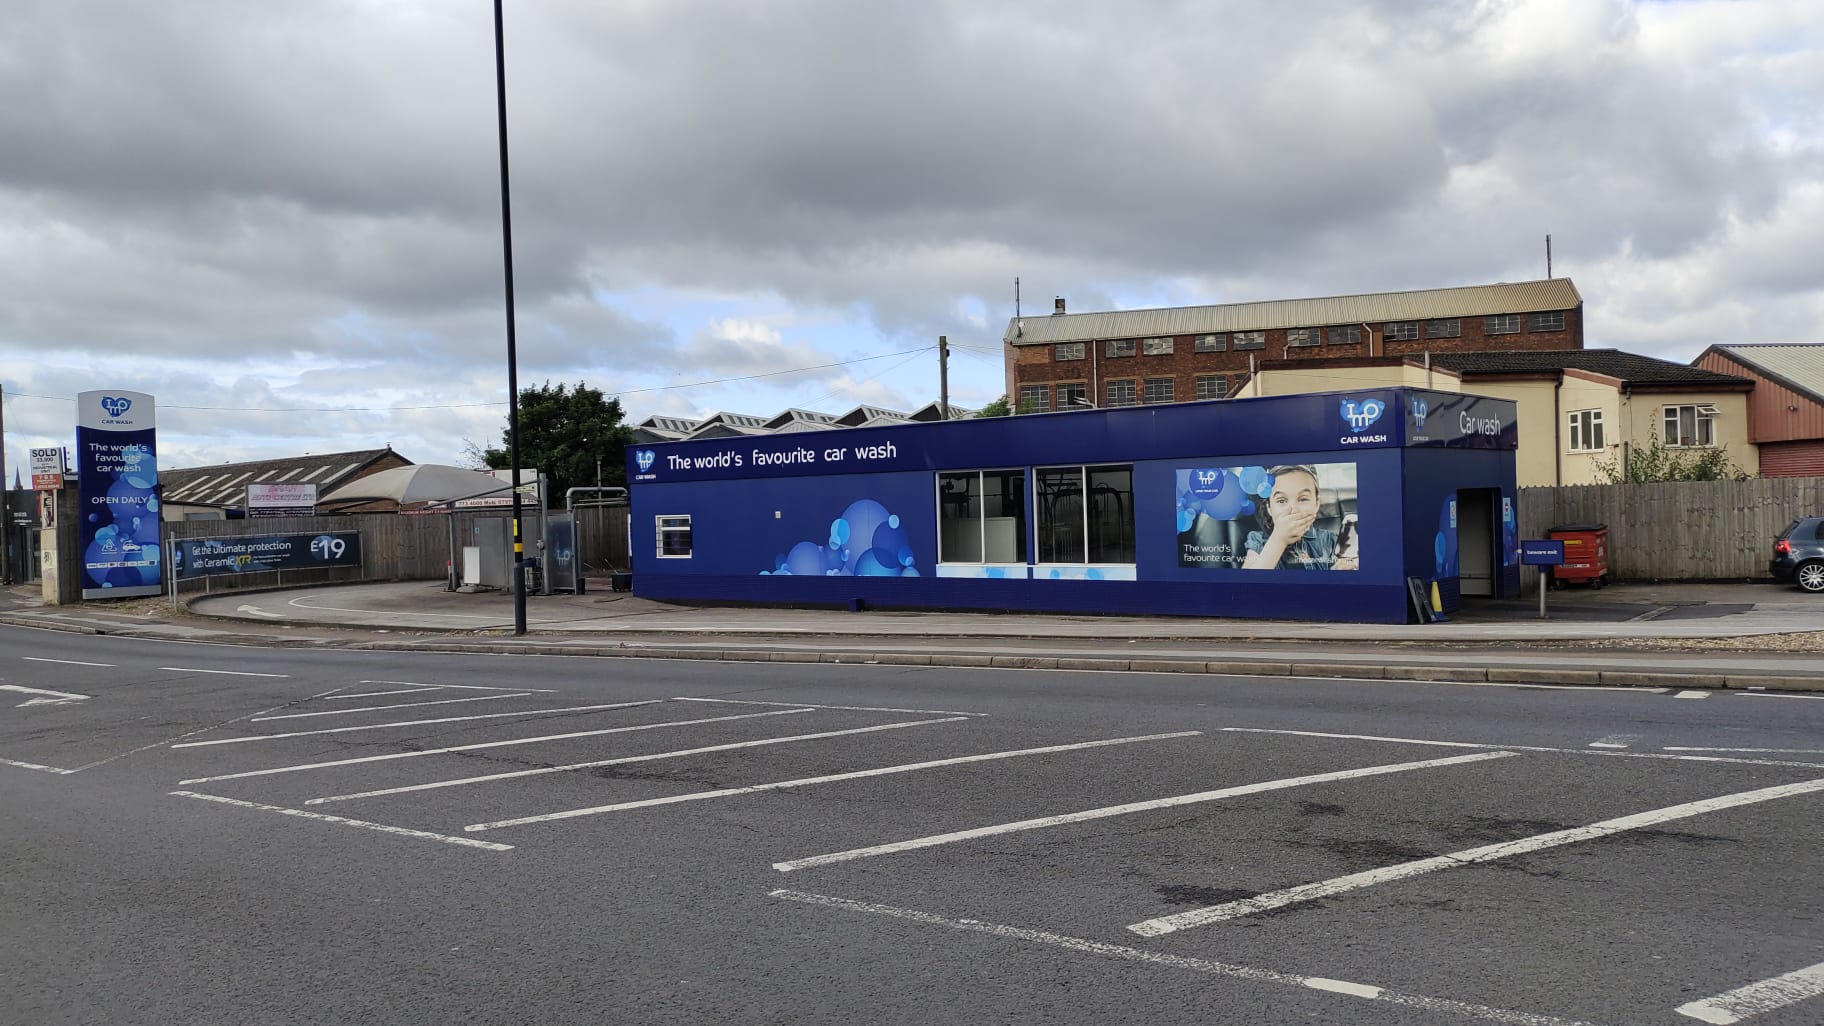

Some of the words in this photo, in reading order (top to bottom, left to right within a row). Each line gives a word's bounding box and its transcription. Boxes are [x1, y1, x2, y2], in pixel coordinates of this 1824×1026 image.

[1459, 411, 1475, 433] Car
[1477, 412, 1501, 436] wash
[1340, 436, 1358, 445] CAR
[1359, 435, 1387, 443] WASH
[88, 443, 108, 452] The
[110, 443, 148, 452] world's
[32, 449, 57, 457] SOLD
[95, 453, 141, 462] favourite
[667, 454, 691, 470] The
[693, 451, 743, 468] world's
[752, 447, 815, 465] favourite
[824, 448, 847, 461] car
[855, 441, 897, 459] wash
[114, 463, 141, 472] wash
[91, 496, 119, 504] OPEN
[121, 496, 148, 504] DAILY
[192, 546, 201, 556] Get
[201, 546, 212, 555] the
[213, 543, 246, 554] ultimate
[247, 541, 292, 553] protection
[1183, 544, 1200, 552] The
[1200, 544, 1231, 552] world's
[192, 559, 204, 569] with
[204, 556, 235, 567] Ceramic
[1183, 554, 1220, 562] favourite
